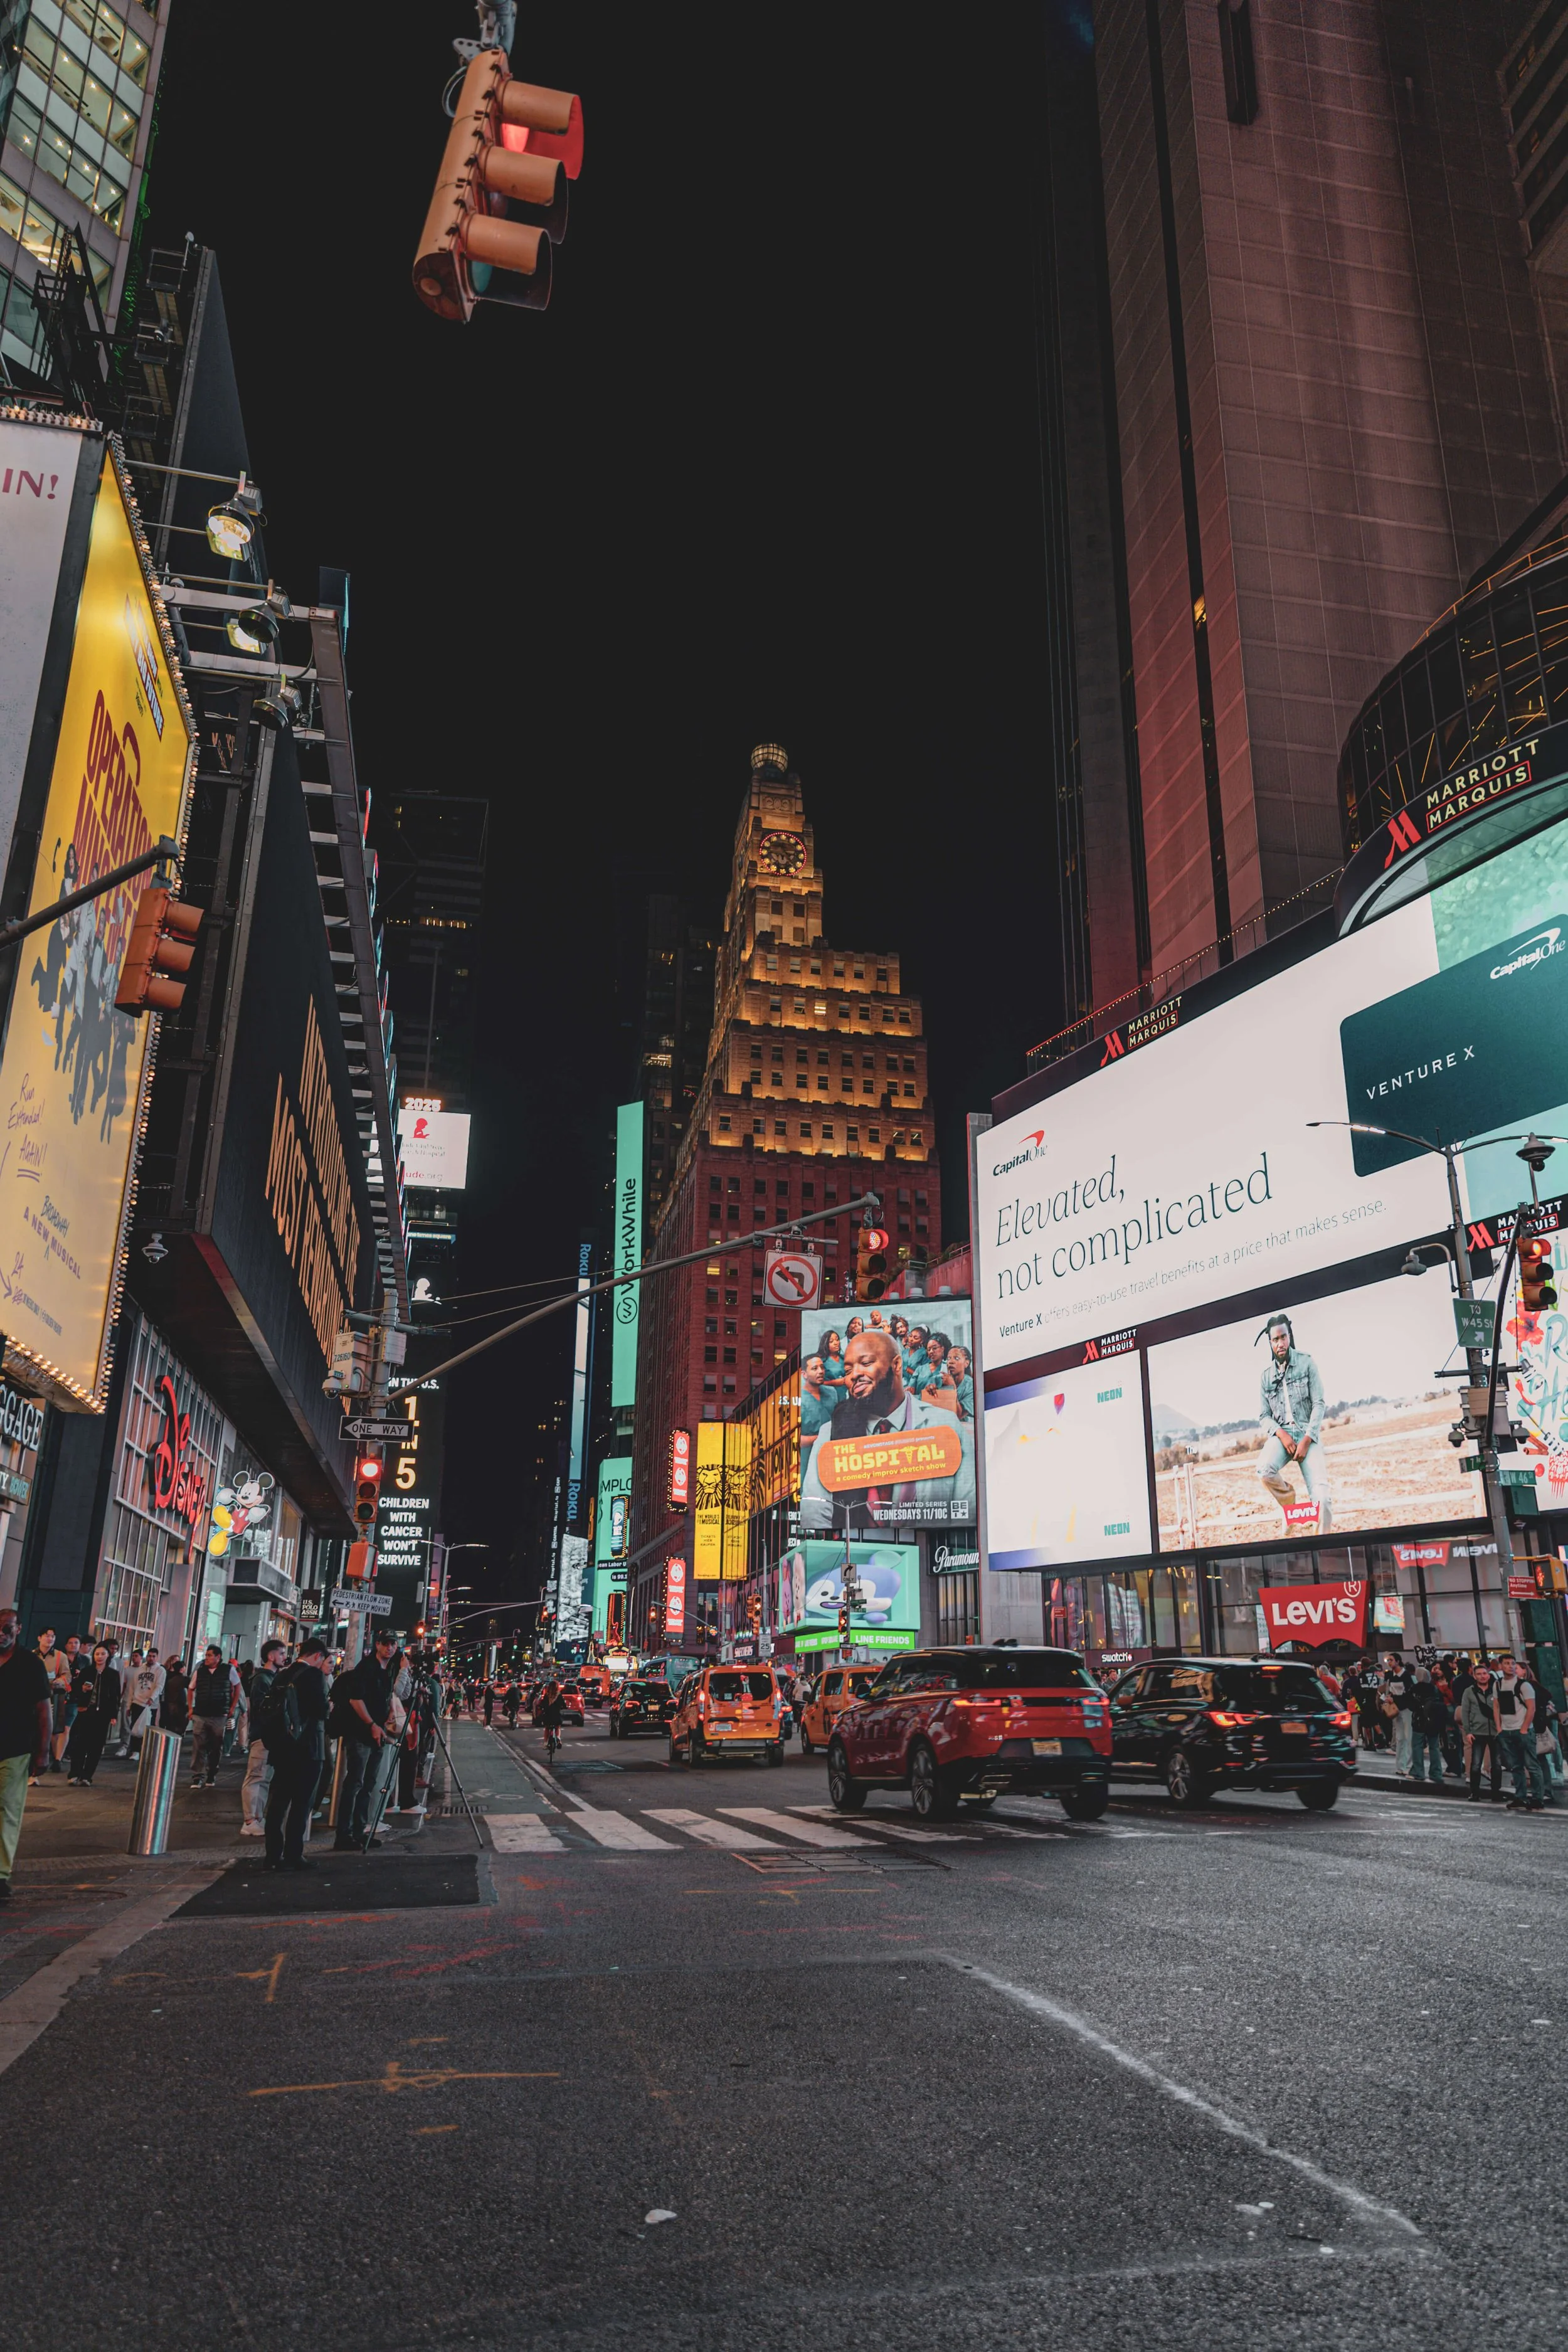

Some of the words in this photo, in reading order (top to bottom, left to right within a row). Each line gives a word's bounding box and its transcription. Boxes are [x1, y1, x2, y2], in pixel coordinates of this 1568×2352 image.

[1426, 739, 1540, 809] MARRIOTT
[1428, 765, 1528, 830] MARQUIS
[1128, 996, 1182, 1034] MARRIOTT
[1129, 1014, 1177, 1047] MARQUIS
[1366, 1052, 1458, 1100] VENTURE
[1464, 1046, 1475, 1061] X
[405, 1098, 442, 1112] 2025
[298, 992, 351, 1269] INTRODUCING
[18, 1133, 48, 1169] AGAIN!
[265, 1073, 307, 1269] MOST
[406, 1172, 443, 1182] ude.org
[996, 1154, 1125, 1248] Elevated,
[1498, 1200, 1562, 1228] MAOTT
[997, 1250, 1043, 1299] not
[1052, 1152, 1272, 1278] complicated
[23, 1206, 29, 1221] A
[31, 1214, 49, 1243] NEW
[50, 1238, 81, 1279] MUSICAL
[621, 1177, 637, 1296] WorkWhile
[344, 1201, 361, 1309] THE
[1000, 1318, 1034, 1338] Venture
[1036, 1313, 1042, 1327] X
[1130, 1271, 1158, 1295] travel
[1161, 1258, 1205, 1284] benefits
[1209, 1254, 1219, 1269] at
[1223, 1253, 1230, 1264] a
[1234, 1239, 1263, 1263] price
[1266, 1230, 1291, 1249] that
[1296, 1217, 1338, 1239] makes
[1342, 1199, 1387, 1225] sense.
[1469, 1305, 1481, 1315] TO
[1461, 1318, 1470, 1328] W
[1470, 1318, 1481, 1328] 45
[1484, 1319, 1493, 1328] St
[1101, 1328, 1137, 1347] MARRIOTT
[1101, 1340, 1133, 1356] MARQUIS
[388, 1377, 399, 1387] IN
[1097, 1387, 1122, 1403] NEON
[405, 1396, 420, 1427] 1
[352, 1424, 373, 1433] ONE
[383, 1425, 404, 1435] WAY
[833, 1443, 856, 1455] THE
[1470, 1458, 1475, 1470] 7
[395, 1457, 416, 1490] 5
[842, 1471, 871, 1481] comedy
[872, 1469, 898, 1478] improv
[900, 1465, 924, 1473] sketch
[1510, 1471, 1517, 1484] W
[1518, 1471, 1529, 1484] 46
[378, 1496, 430, 1510] CHILDREN
[389, 1512, 416, 1523] WITH
[873, 1509, 921, 1521] WEDNESDAYS
[923, 1508, 948, 1520] 11/10C
[380, 1525, 423, 1537] CANCER
[1104, 1522, 1131, 1536] NEON
[383, 1540, 418, 1552] WON'T
[377, 1553, 421, 1566] SURVIVE
[933, 1545, 980, 1573] Paramoun
[333, 1590, 363, 1602] PEDESTRIAN
[364, 1594, 378, 1602] FLOW
[378, 1597, 391, 1605] ZONE
[371, 1604, 389, 1614] MOVING
[856, 1635, 874, 1644] LINE
[875, 1636, 910, 1645] FRIENDS
[1101, 1652, 1128, 1662] swatch
